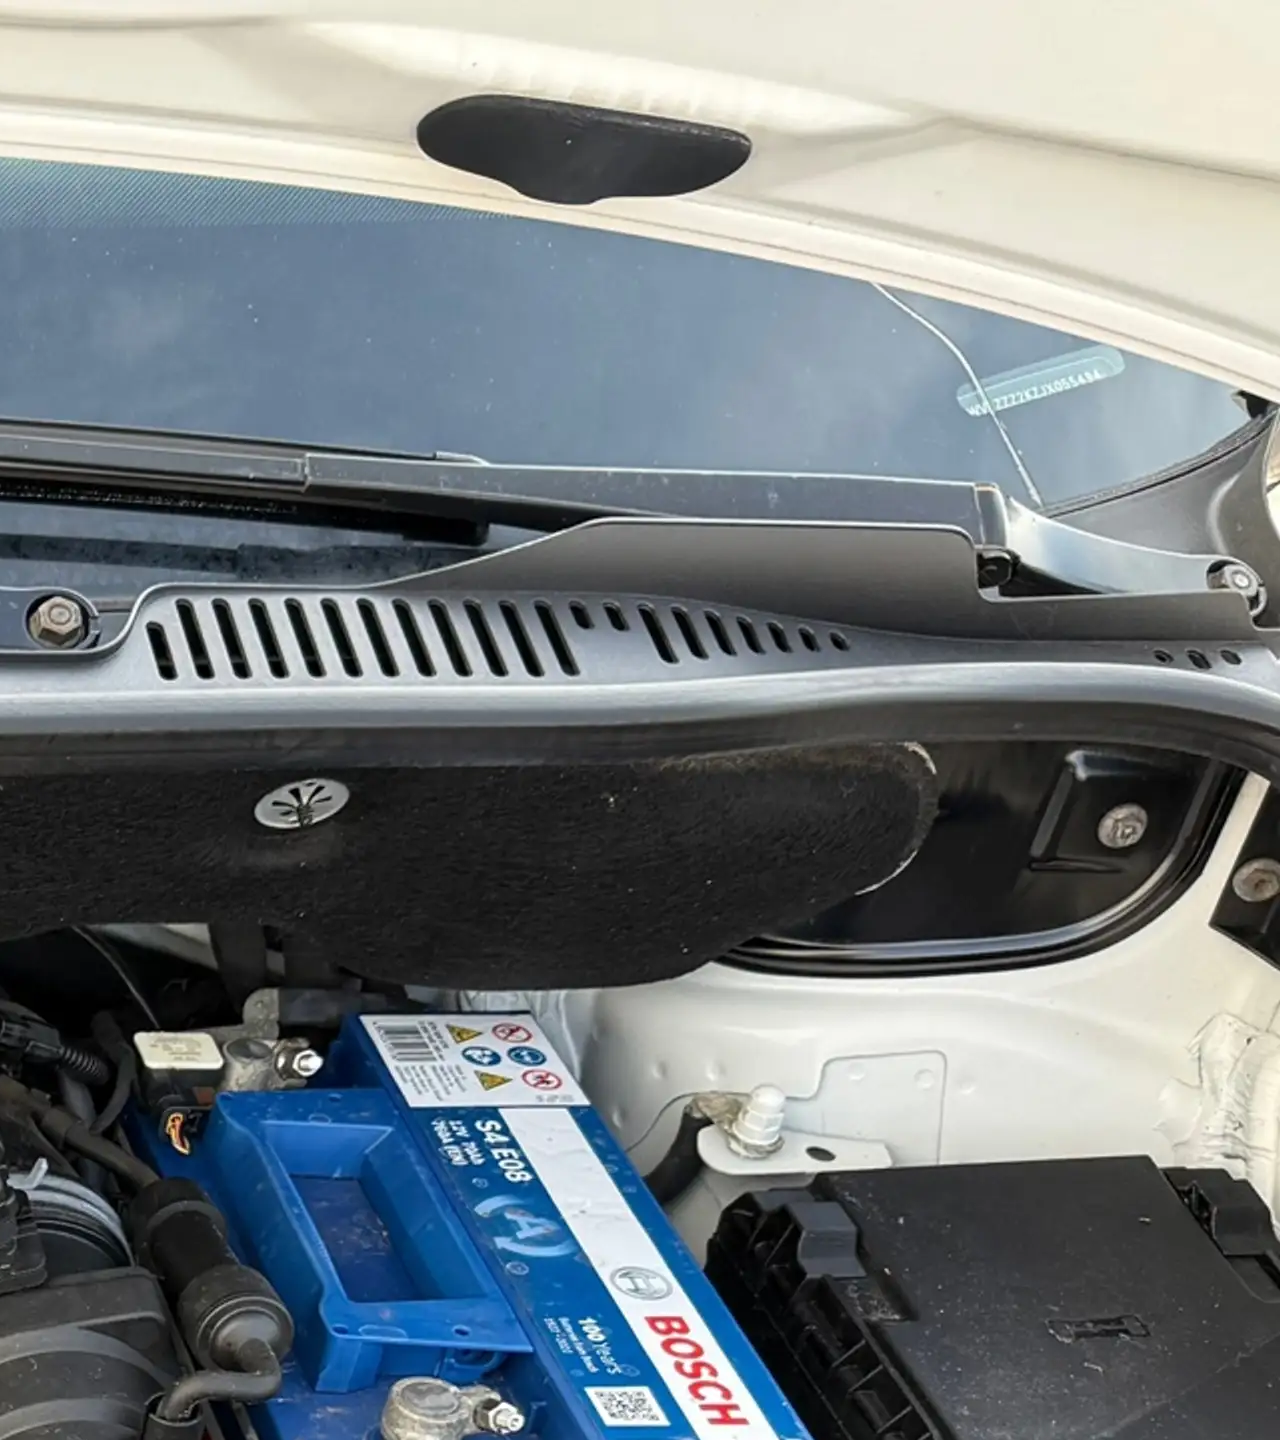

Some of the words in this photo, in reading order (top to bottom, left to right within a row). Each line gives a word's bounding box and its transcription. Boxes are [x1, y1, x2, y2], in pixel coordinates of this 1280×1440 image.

[474, 1119, 510, 1144] S4
[491, 1148, 534, 1183] E08
[577, 1315, 606, 1342] 100
[592, 1342, 623, 1375] Years
[644, 1316, 749, 1425] BOSCH
